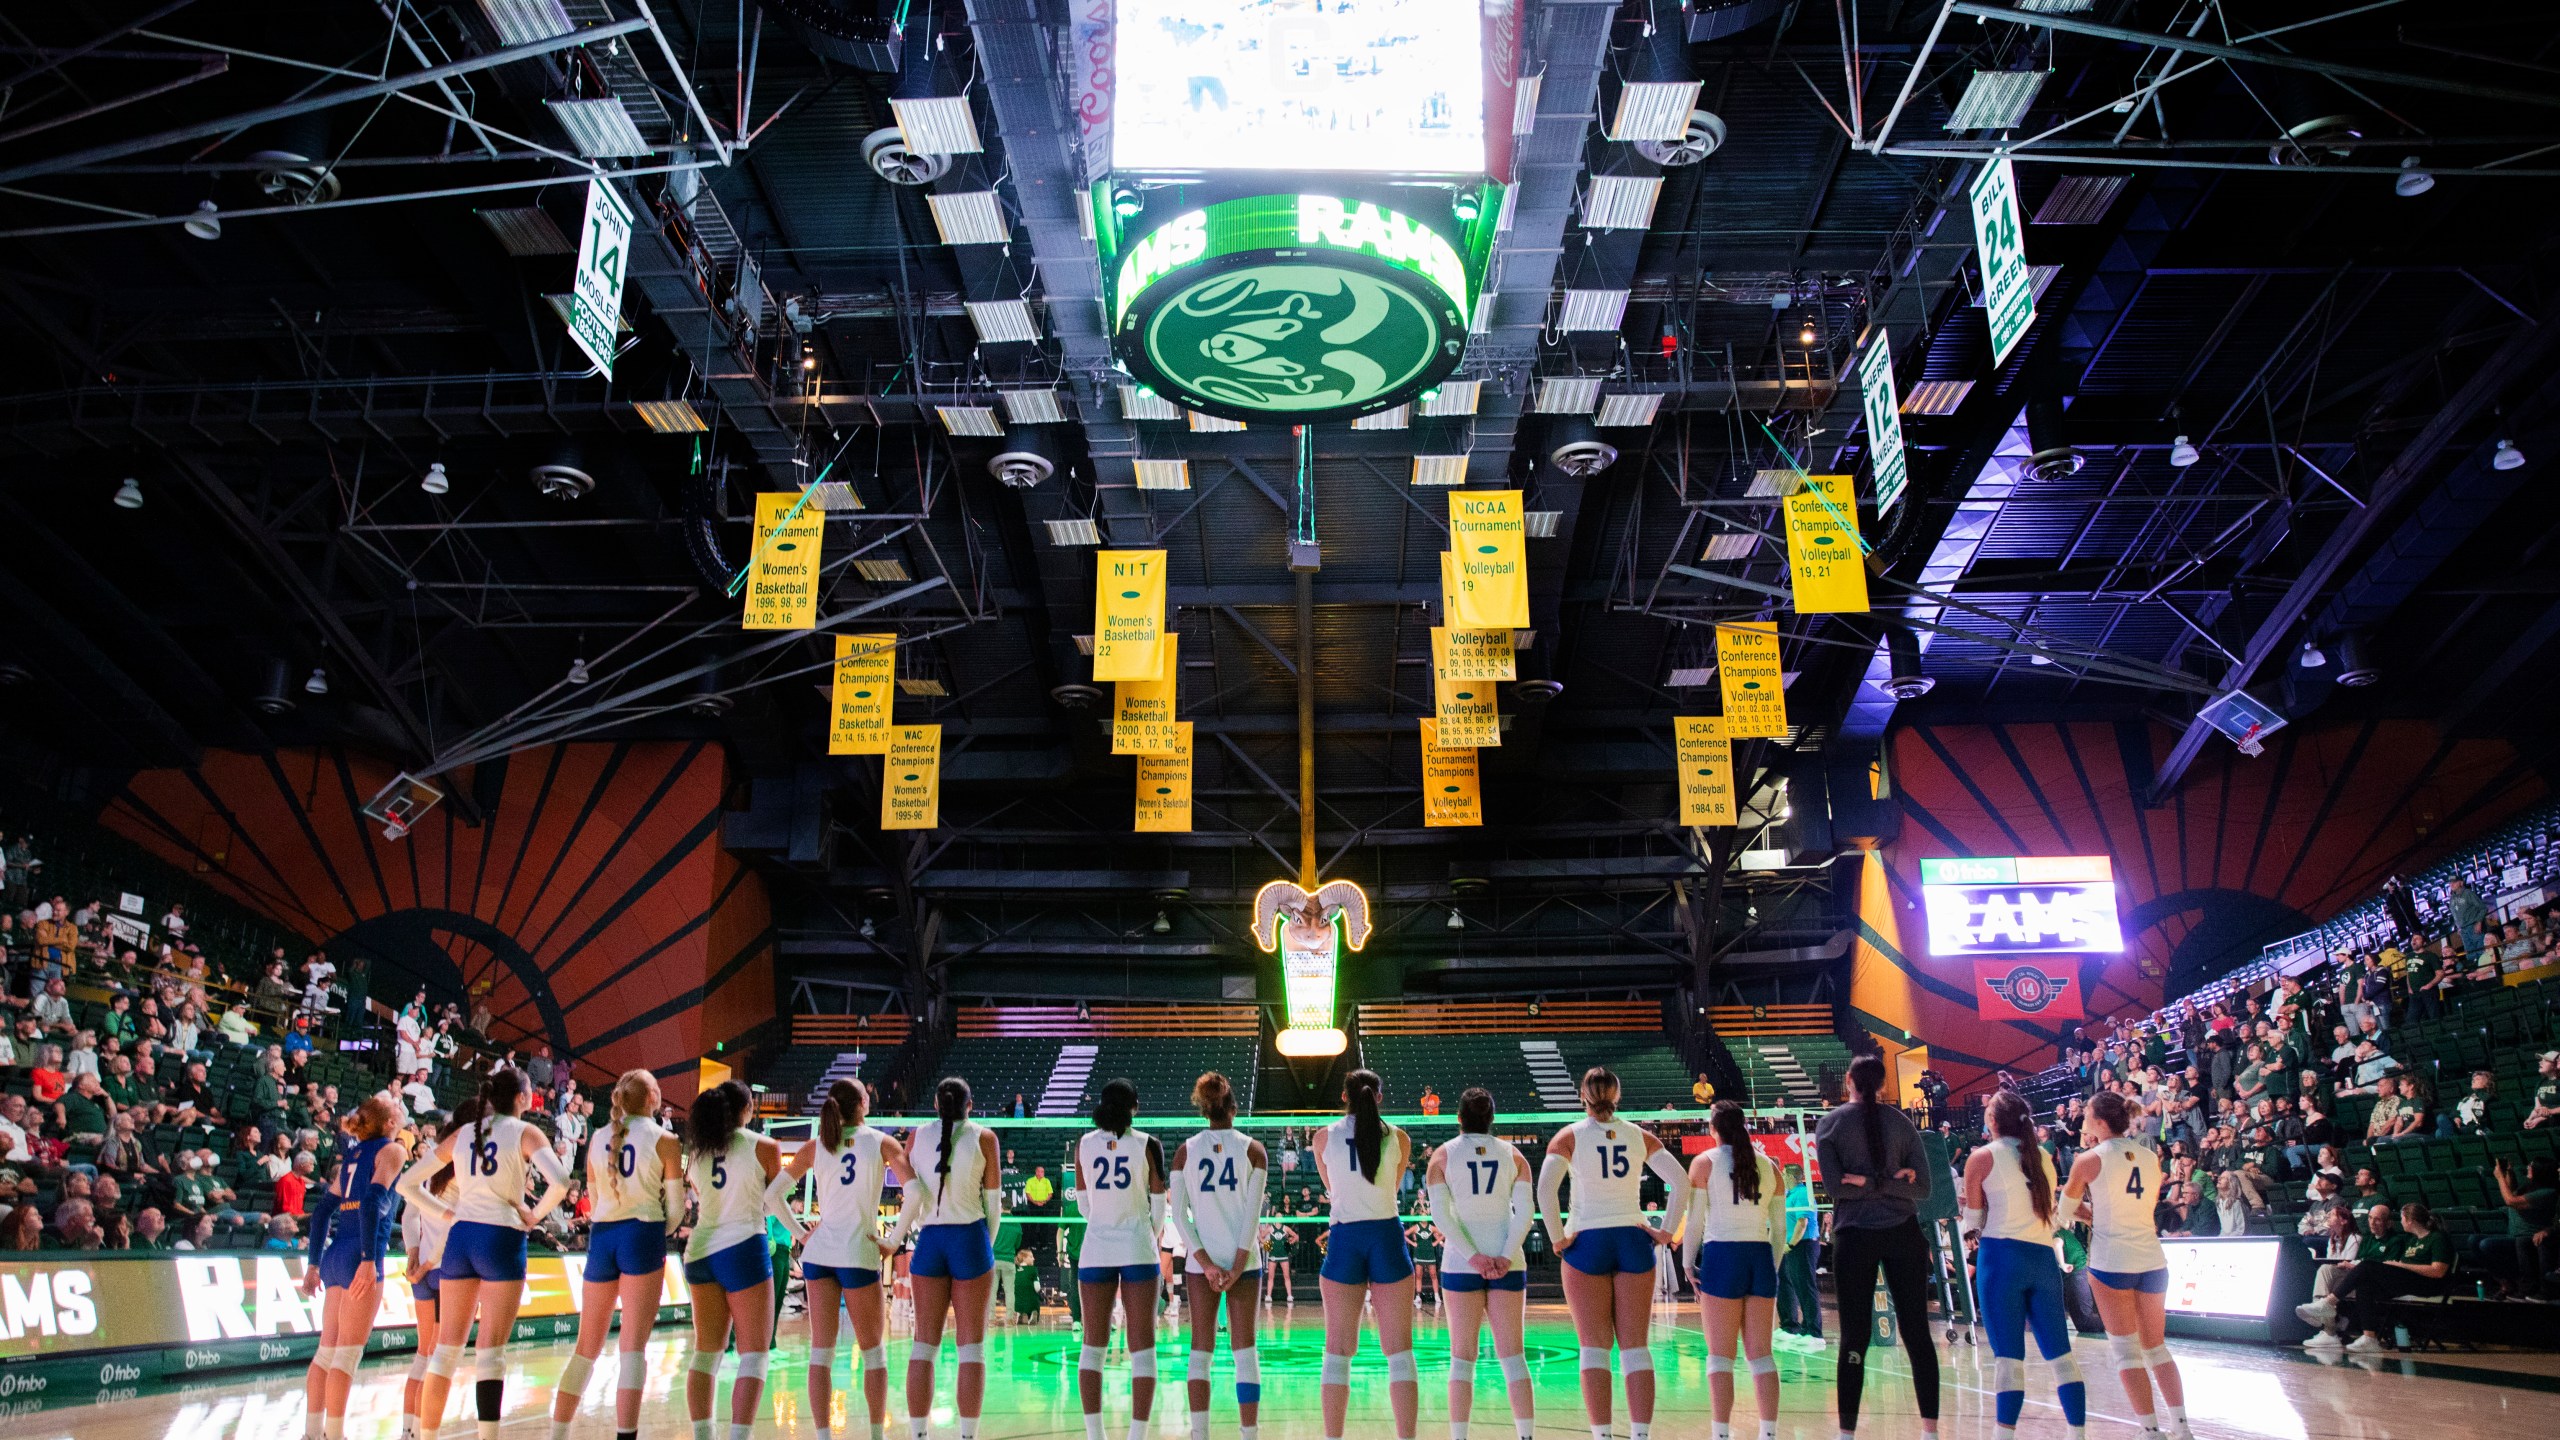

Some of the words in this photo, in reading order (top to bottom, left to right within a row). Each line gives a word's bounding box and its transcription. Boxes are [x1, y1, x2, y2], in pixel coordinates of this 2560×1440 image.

[1982, 175, 2005, 217] BILL
[596, 197, 623, 242] JOHN
[1985, 195, 2016, 280] 24
[592, 217, 620, 298] 14
[1989, 253, 2027, 310] GREEN
[578, 268, 619, 328] MOSLEY
[574, 297, 614, 348] FOOTBALL
[1863, 349, 1889, 398] SHERRI
[1870, 381, 1892, 443] 12
[1800, 482, 1835, 494] MWC
[1465, 501, 1506, 514] NCAA
[1791, 500, 1848, 513] Conference
[775, 508, 804, 520] NCAA
[759, 525, 818, 537] Tournament
[1453, 519, 1521, 532] Tournament
[1792, 519, 1852, 534] Champions
[1800, 548, 1851, 563] Volleyball
[763, 563, 807, 575] Women's
[1463, 561, 1515, 577] Volleyball
[1800, 566, 1816, 579] 19,
[1819, 566, 1831, 577] 21
[755, 582, 807, 594] Basketball
[1462, 580, 1474, 591] 19
[755, 598, 777, 608] 1996,
[780, 598, 793, 608] 98,
[797, 597, 807, 607] 99
[745, 613, 759, 624] 01,
[763, 614, 776, 624] 02,
[781, 613, 792, 623] 16
[1108, 615, 1152, 627] Women's
[1104, 629, 1155, 641] Basketball
[1451, 632, 1507, 647] Volleyball
[1733, 634, 1762, 646] MWC
[851, 643, 881, 654] MWC
[1099, 646, 1111, 656] 22
[1721, 651, 1777, 662] Conference
[841, 658, 889, 668] Conference
[1724, 666, 1777, 679] Champions
[840, 673, 889, 685] Champions
[1125, 697, 1166, 708] Women's
[1731, 690, 1774, 704] Volleyball
[842, 703, 880, 713] Women's
[1442, 702, 1493, 716] Volleyball
[1121, 711, 1168, 722] Basketball
[839, 718, 884, 730] Basketball
[1689, 723, 1714, 734] HCAC
[904, 730, 922, 740] WAC
[891, 744, 935, 754] Conference
[1679, 738, 1727, 749] Conference
[891, 756, 934, 767] Champions
[1141, 757, 1189, 767] Tournament
[1426, 754, 1475, 764] Tournament
[1680, 752, 1728, 765] Champions
[1141, 770, 1187, 782] Champions
[1428, 766, 1474, 779] Champions
[894, 785, 927, 794] Women's
[1687, 784, 1726, 796] Volleyball
[892, 798, 930, 808] Basketball
[1138, 798, 1161, 808] Women's
[1163, 798, 1189, 808] Basketball
[1433, 796, 1472, 809] Volleyball
[1138, 811, 1150, 820] 01,
[1154, 811, 1163, 819] 16
[1691, 804, 1713, 815] 1984,
[1714, 804, 1725, 814] 85
[895, 811, 922, 821] 1995-96
[2021, 983, 2035, 996] 14
[1078, 1009, 1089, 1020] A
[1529, 1004, 1539, 1015] S
[1755, 1007, 1765, 1018] S
[858, 1016, 868, 1027] A
[470, 1142, 498, 1176] 13
[1597, 1145, 1630, 1179] 15
[711, 1156, 727, 1190] 5
[840, 1153, 856, 1185] 3
[1093, 1156, 1131, 1190] 25
[1199, 1157, 1238, 1192] 24
[345, 1163, 358, 1198] 7
[1467, 1160, 1498, 1195] 17
[2126, 1167, 2144, 1199] 4
[270, 1344, 290, 1358] fnbo
[198, 1352, 221, 1366] fnbo
[116, 1364, 141, 1381] fnbo
[17, 1376, 47, 1394] fnbo
